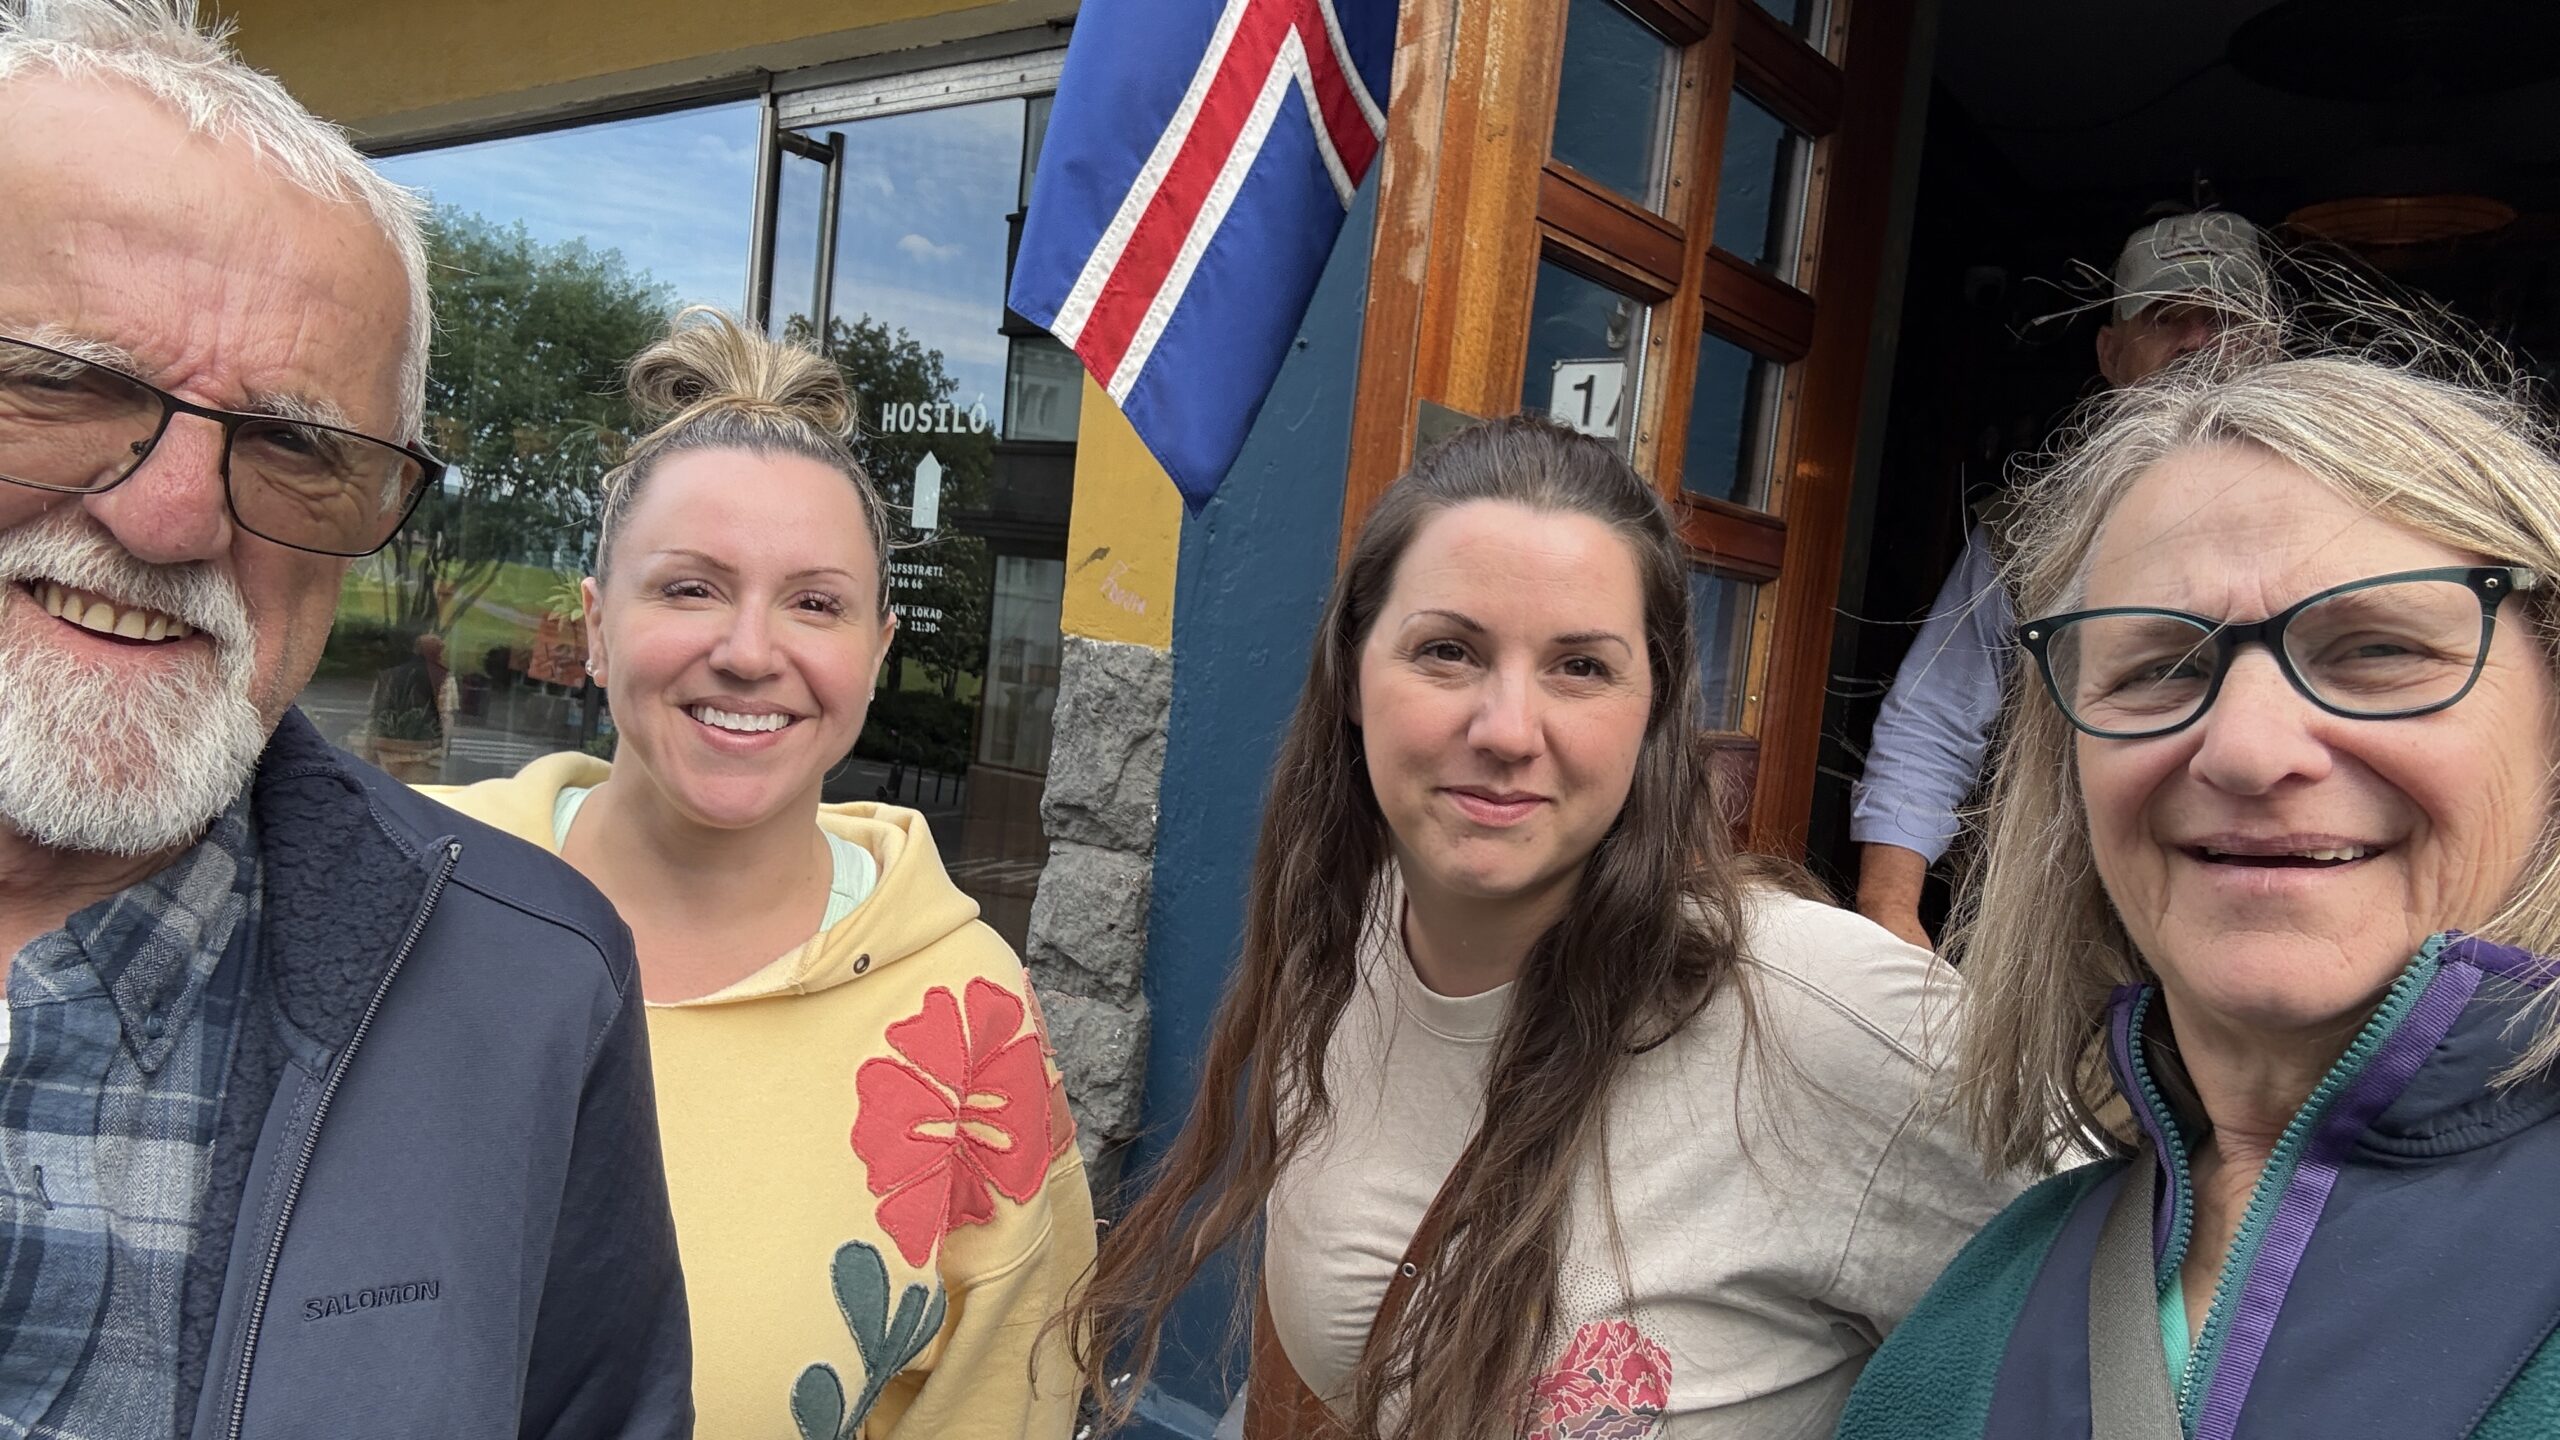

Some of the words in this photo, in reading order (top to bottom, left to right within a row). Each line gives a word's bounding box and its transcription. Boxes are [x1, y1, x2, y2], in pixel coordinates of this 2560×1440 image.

[881, 392, 987, 434] HOSILÓ
[898, 577, 909, 588] 66
[911, 578, 923, 590] 66
[304, 1281, 439, 1321] SALOMON
